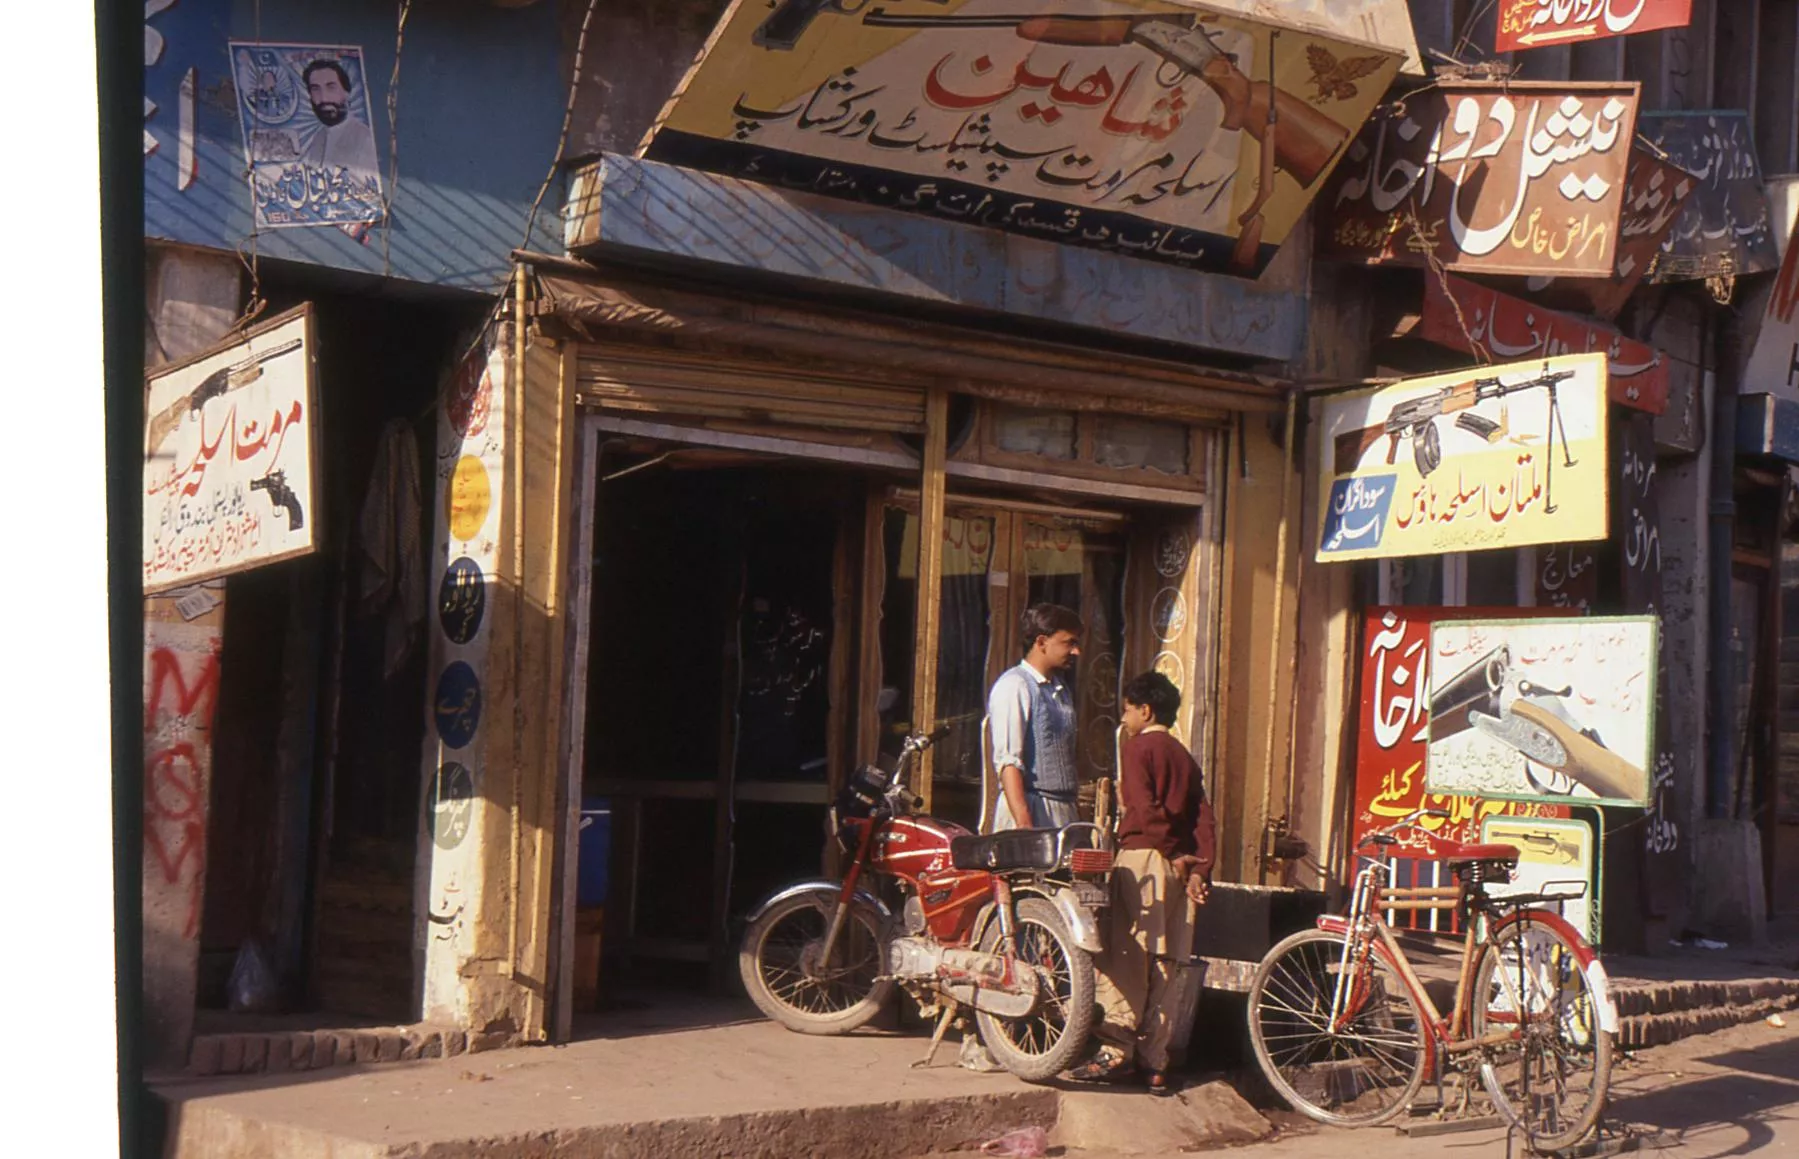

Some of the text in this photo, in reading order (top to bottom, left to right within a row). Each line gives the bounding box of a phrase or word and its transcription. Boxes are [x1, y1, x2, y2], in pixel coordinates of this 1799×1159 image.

[732, 66, 884, 141] ورکشاپ
[1034, 152, 1174, 204] مرمت
[1120, 149, 1238, 215] اسلحہ
[1334, 97, 1517, 214] دواخانہ
[1449, 95, 1626, 257] نیشنل
[1508, 205, 1545, 255] خاص
[1547, 213, 1609, 262] امراض
[176, 402, 237, 503] اسلحہ
[234, 398, 304, 477] مرمت
[1436, 462, 1488, 526] اسلحہ
[1486, 451, 1545, 524] ملتان
